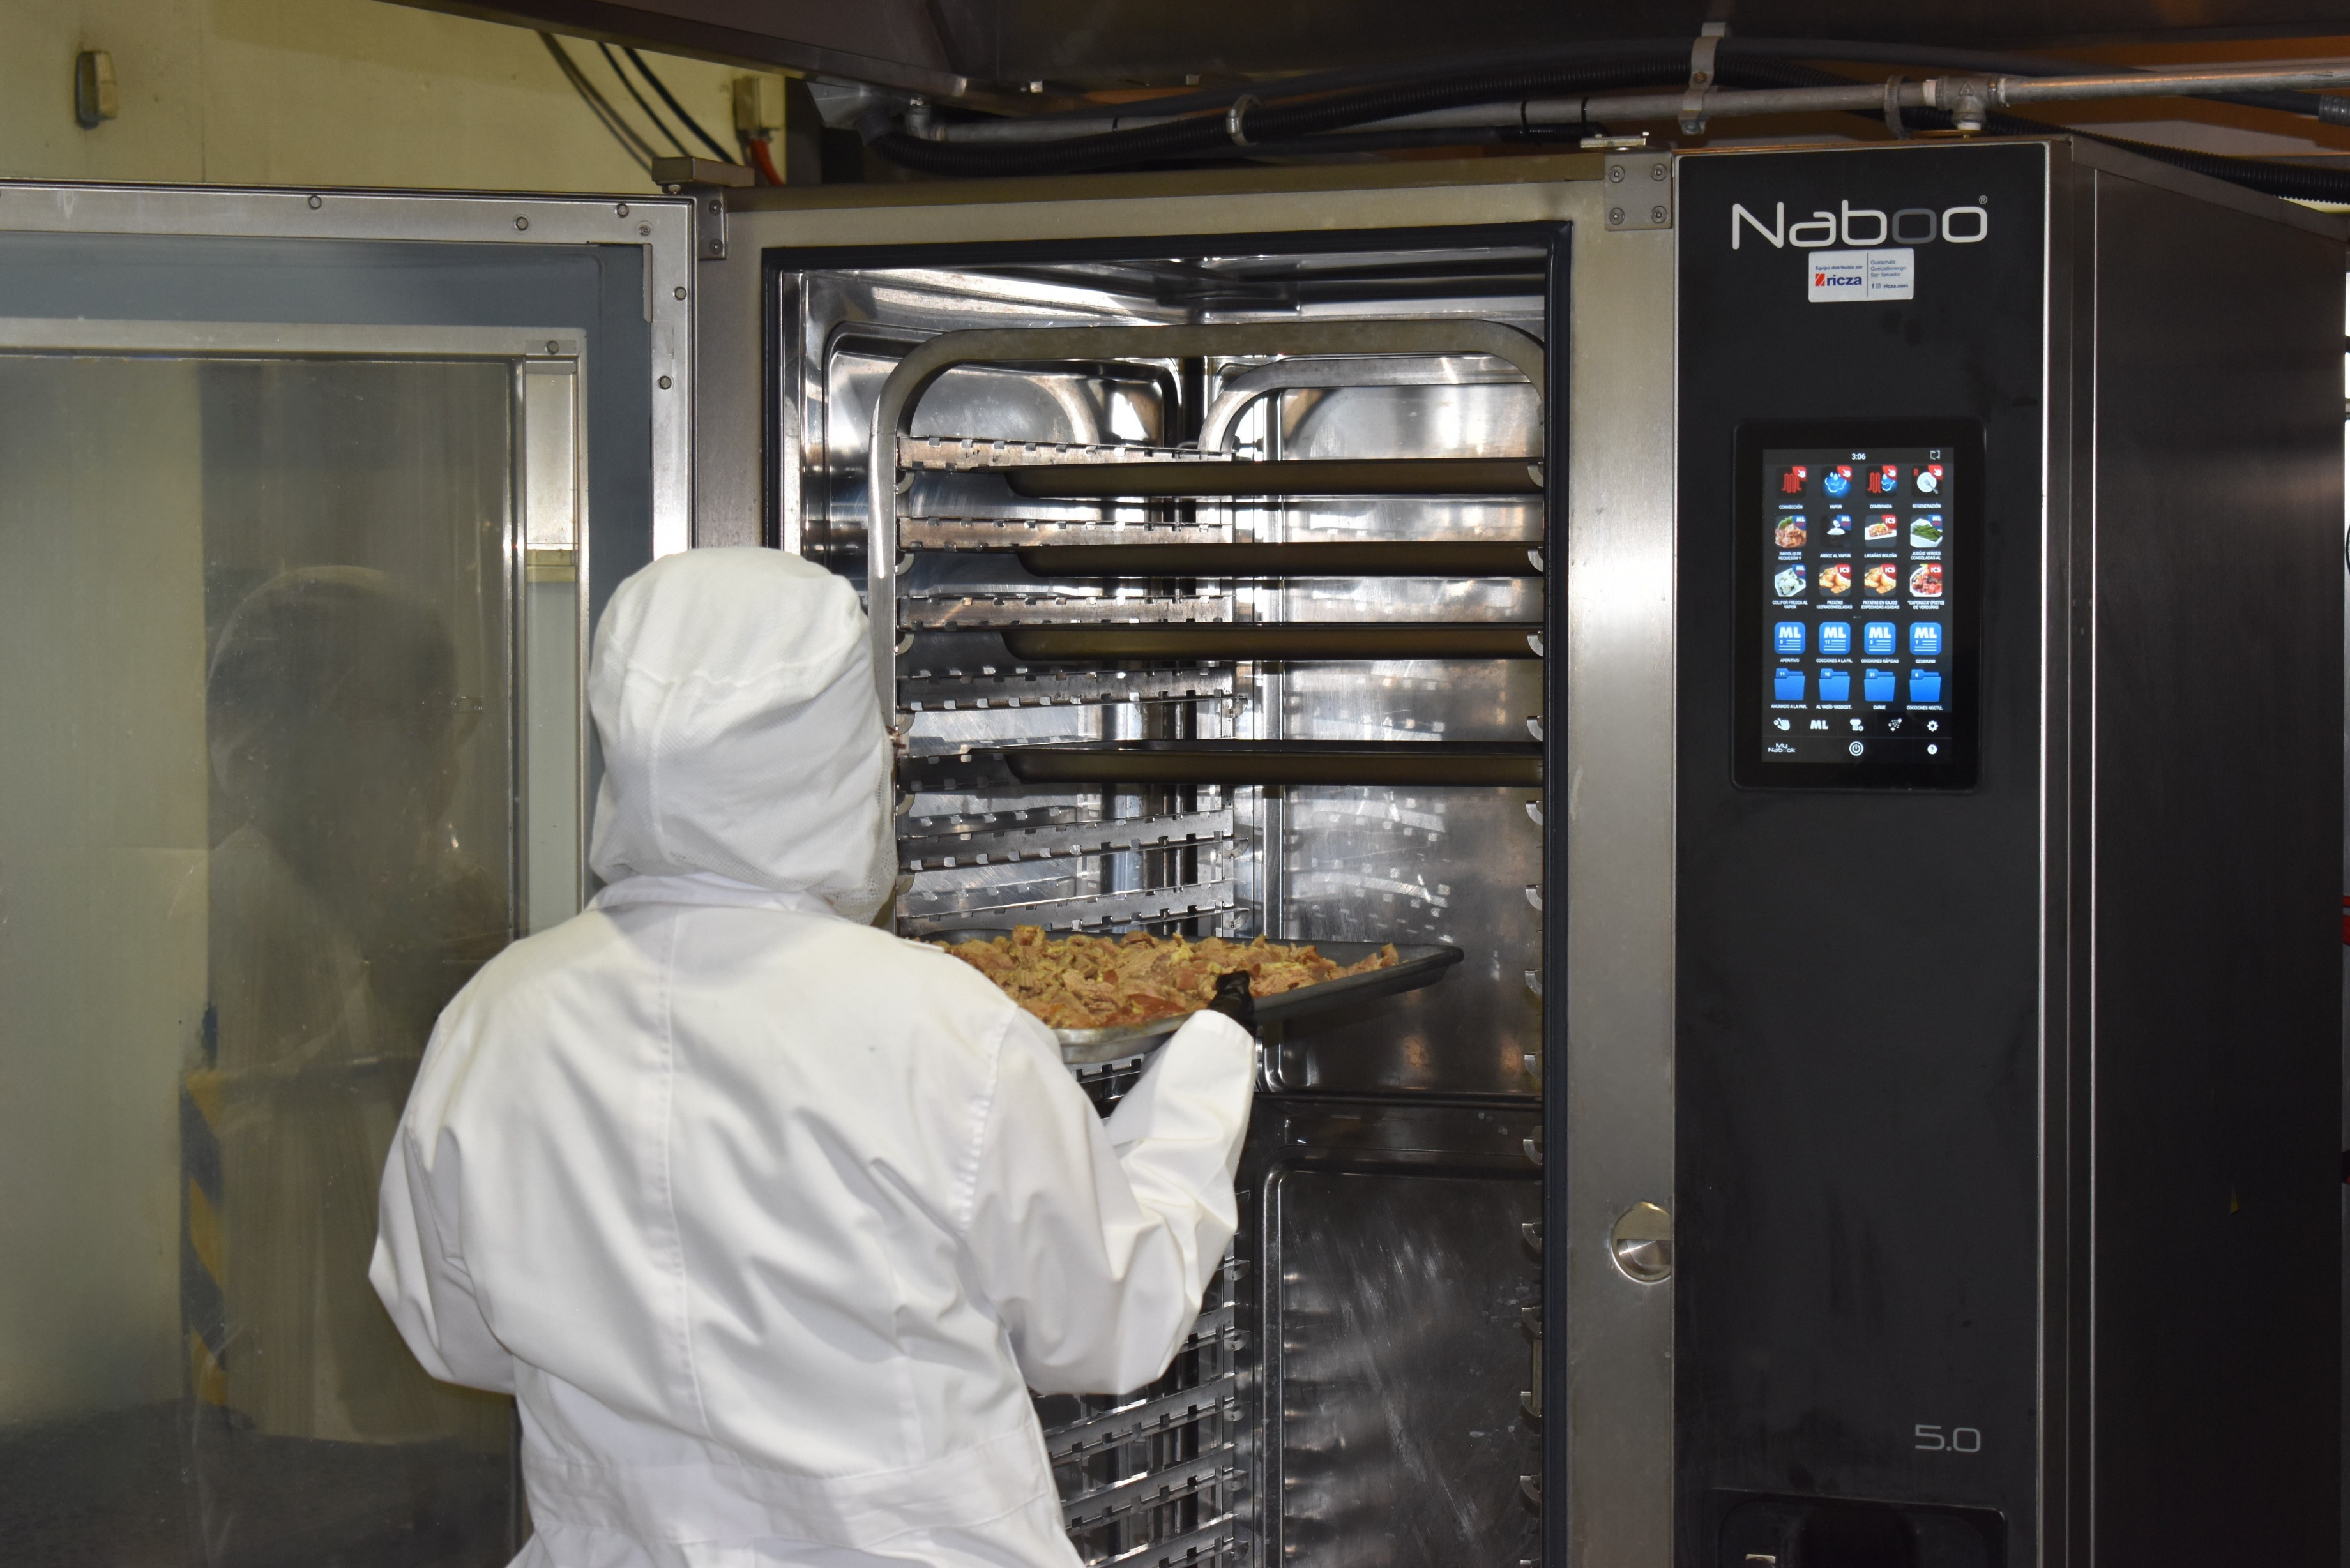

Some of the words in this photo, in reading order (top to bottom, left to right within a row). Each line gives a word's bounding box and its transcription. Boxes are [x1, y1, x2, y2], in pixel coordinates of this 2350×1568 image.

[1827, 275, 1862, 286] ricza
[1778, 626, 1801, 638] ML
[1824, 626, 1846, 638] ML
[1869, 626, 1891, 639] ML
[1914, 627, 1937, 639] ML
[1810, 720, 1828, 729] ML
[1916, 1424, 1980, 1452] 5.0
